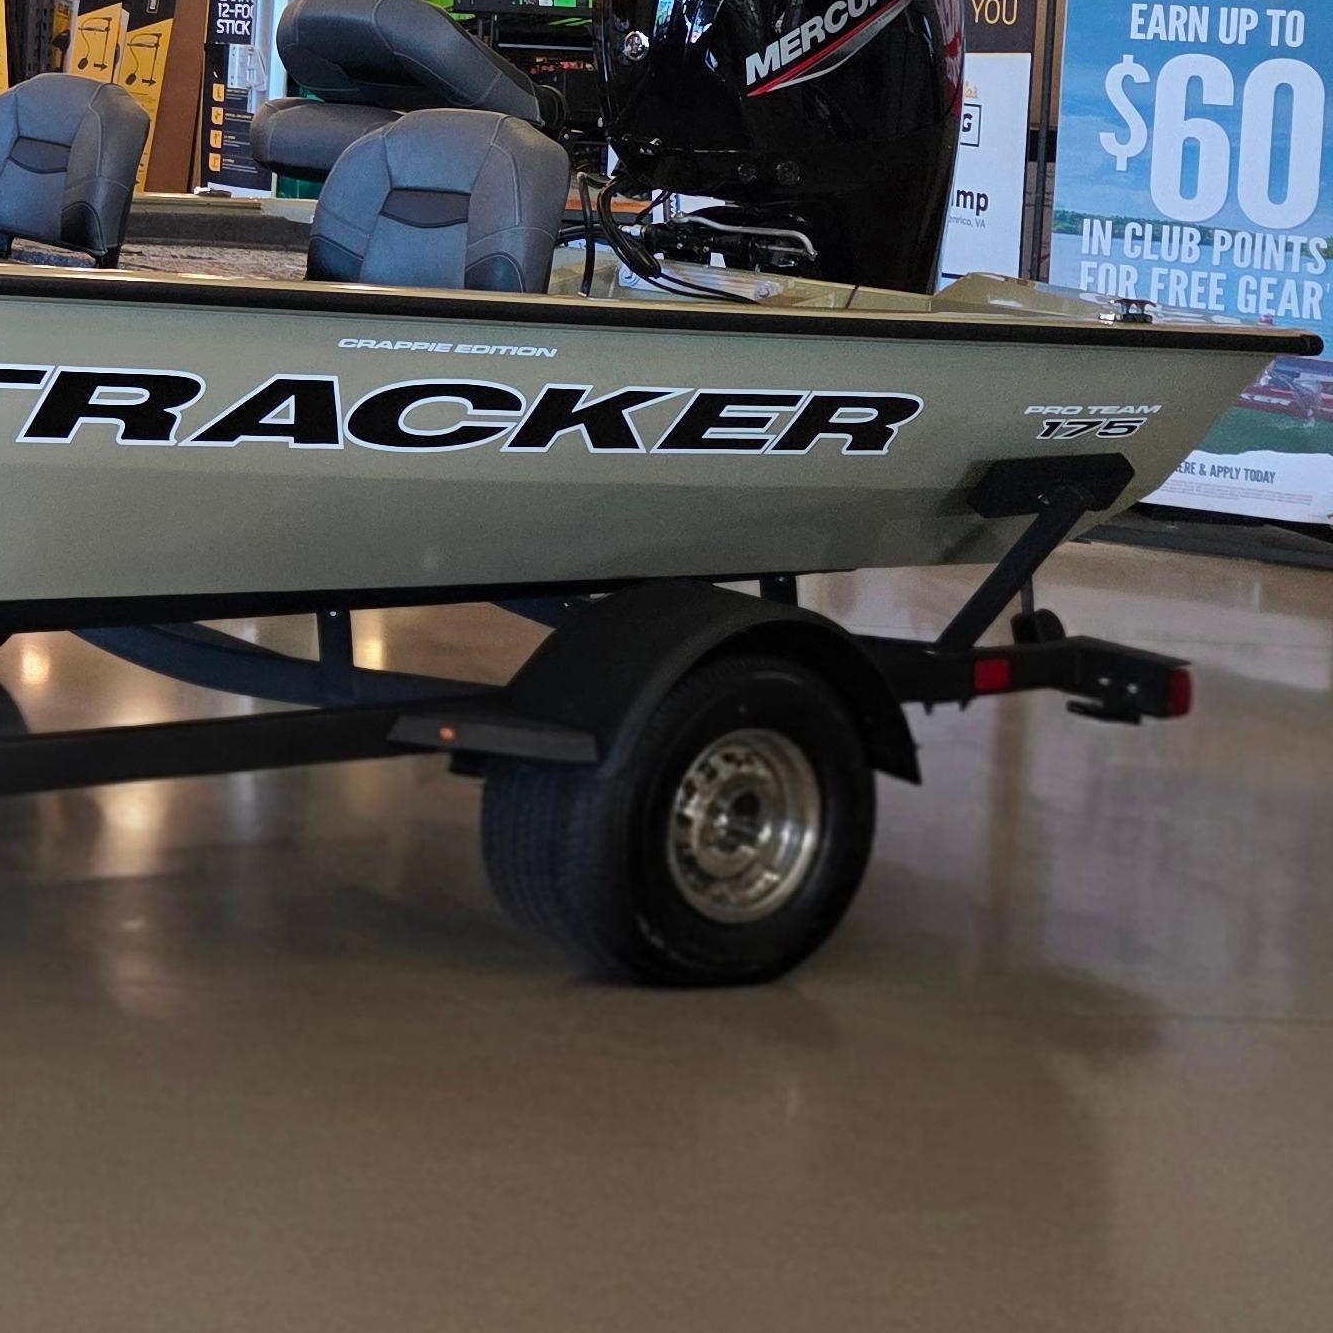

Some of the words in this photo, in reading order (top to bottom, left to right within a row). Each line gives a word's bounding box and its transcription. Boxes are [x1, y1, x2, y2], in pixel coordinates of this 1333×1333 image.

[217, 3, 254, 18] 12-FO
[216, 19, 250, 35] STICK
[1129, 2, 1210, 43] EARN
[1218, 7, 1259, 46] UP
[1266, 8, 1305, 48] TO
[1099, 52, 1326, 229] $60
[951, 188, 989, 215] mp
[976, 219, 986, 229] VA
[1081, 217, 1112, 257] IN
[1123, 221, 1201, 265] CLUB
[1212, 229, 1328, 275] POINTS
[1079, 260, 1140, 299] FOR
[1150, 267, 1228, 311] FREE
[337, 338, 453, 353] CRAPPIE
[453, 344, 558, 358] EDITION
[1023, 405, 1083, 415] PRO
[1086, 404, 1162, 414] TEAM
[1036, 417, 1148, 440] 175
[1175, 461, 1196, 475] ERE
[1199, 464, 1206, 475] &
[1209, 465, 1241, 480] APPLY
[1244, 468, 1276, 484] TODAY
